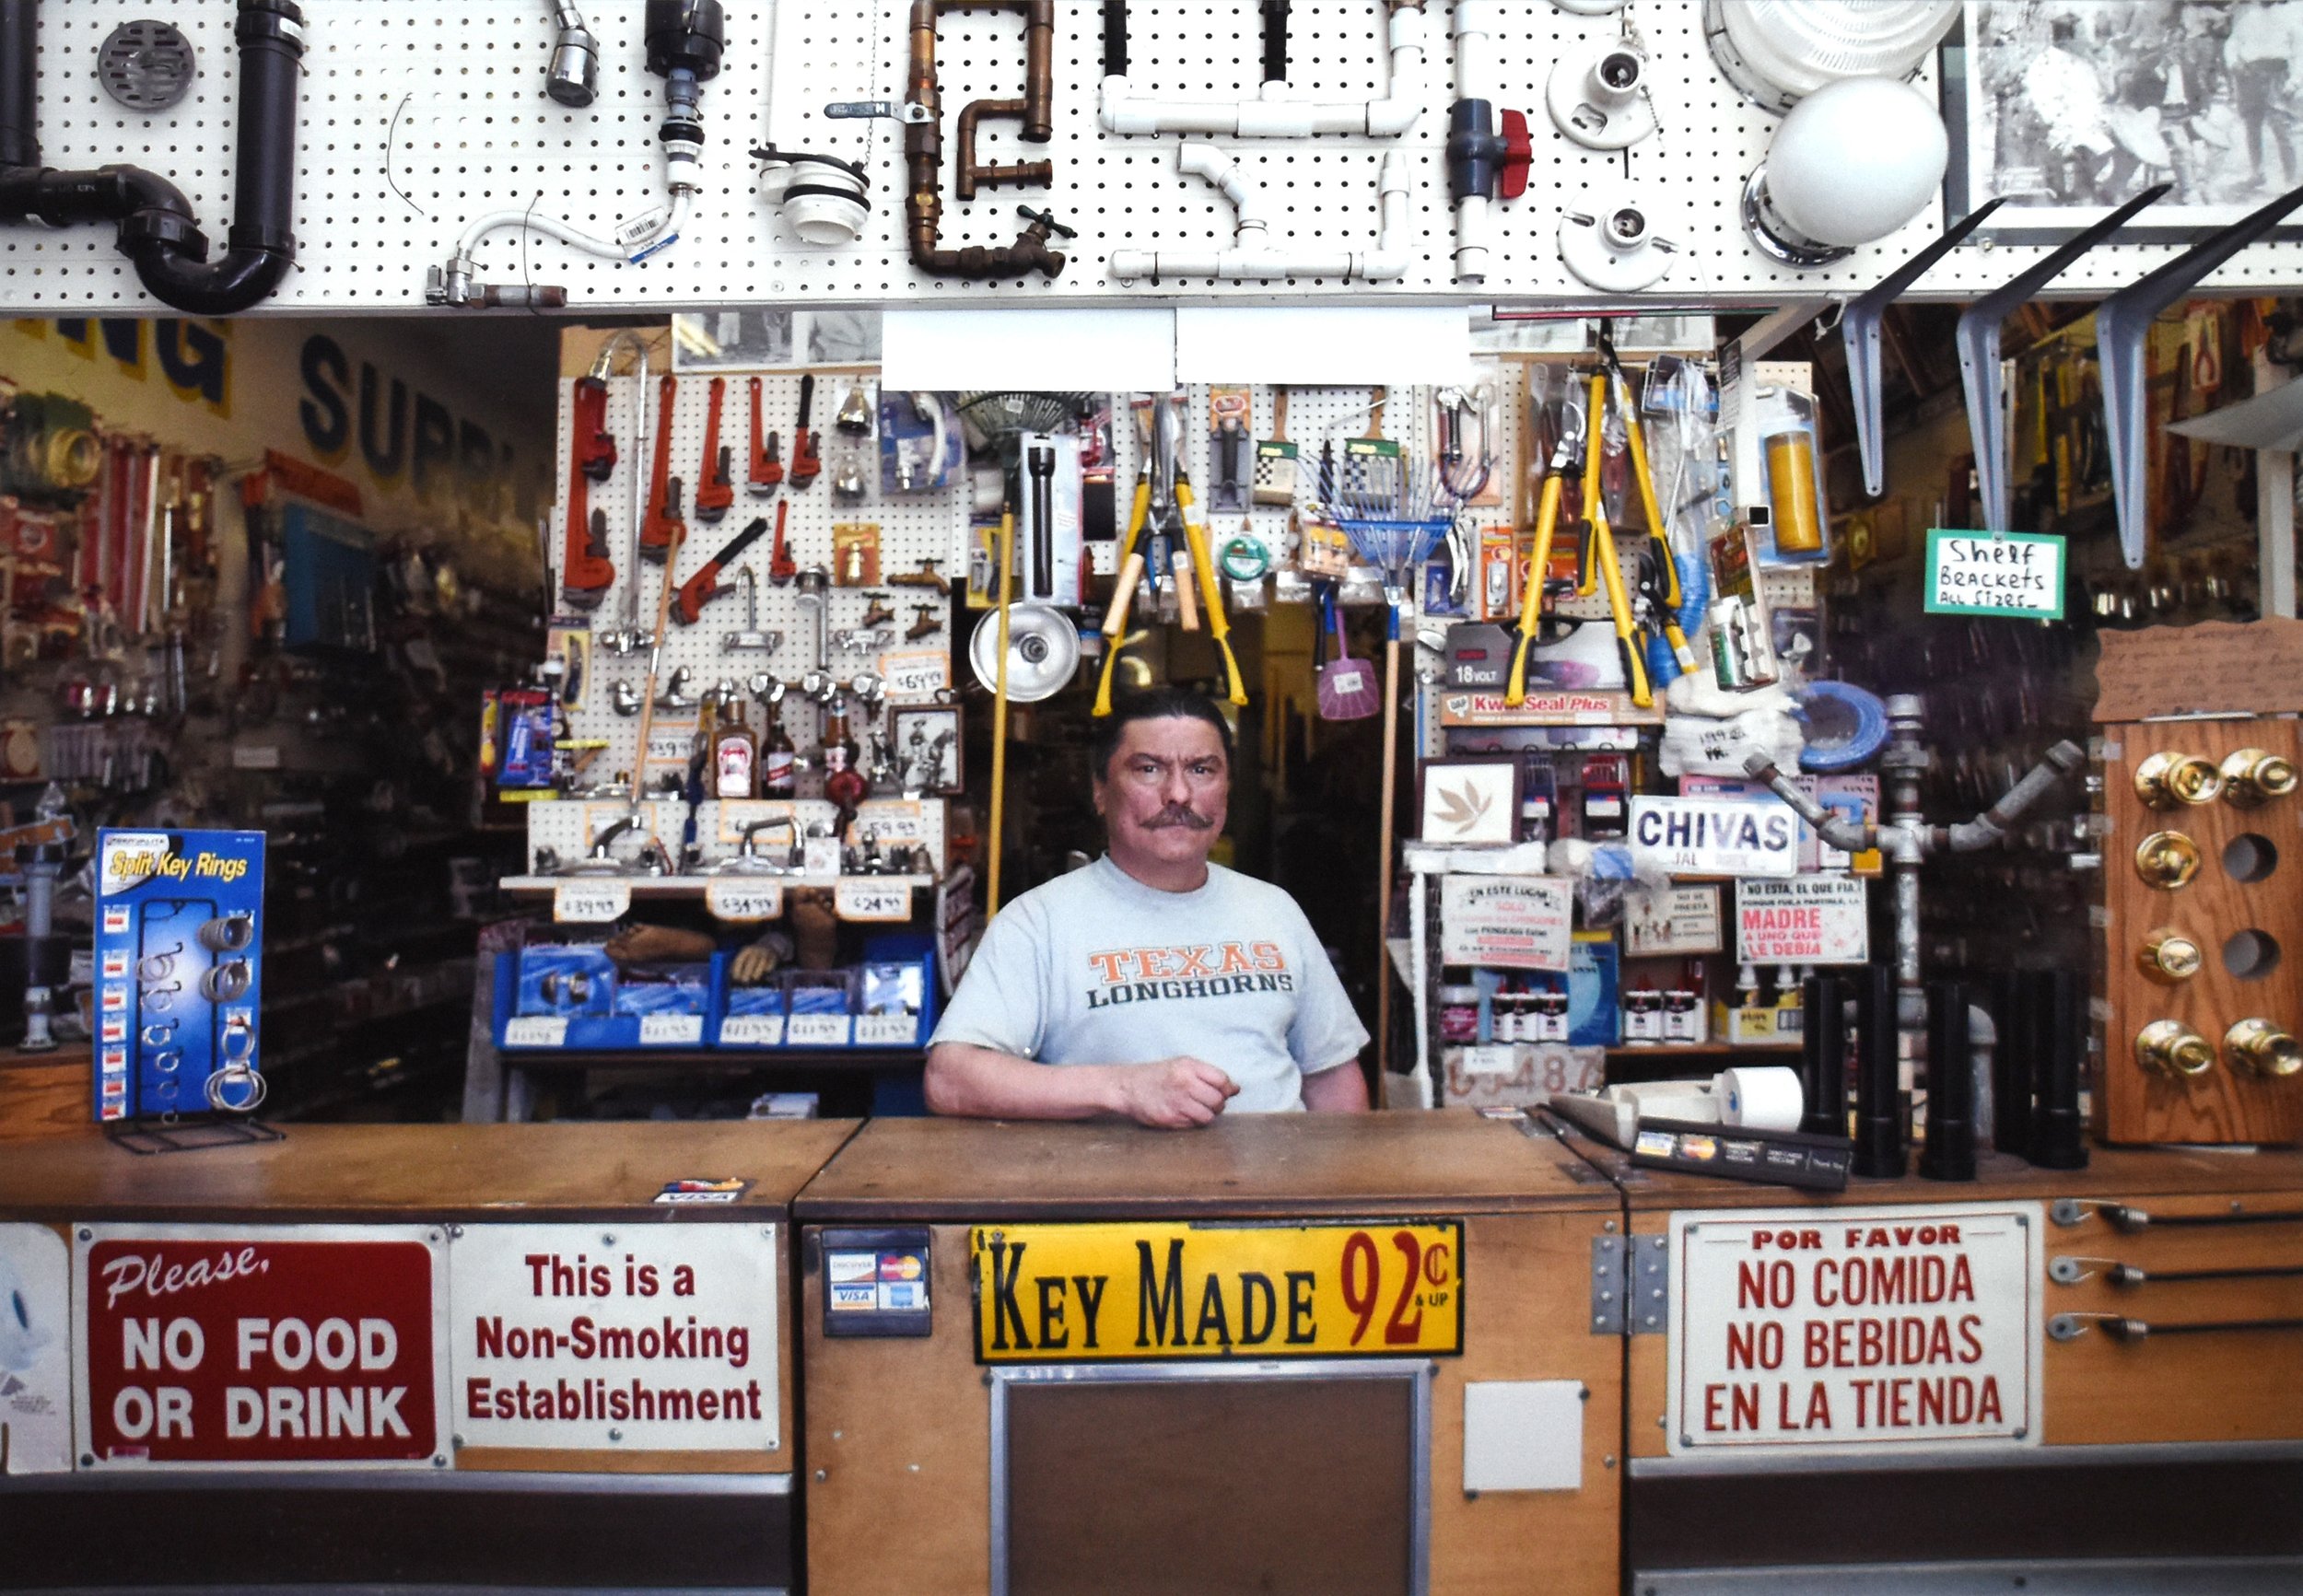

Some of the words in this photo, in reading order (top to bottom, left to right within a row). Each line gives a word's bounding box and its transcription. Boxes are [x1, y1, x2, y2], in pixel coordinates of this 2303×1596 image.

[1949, 540, 2036, 565] Shelf
[1455, 665, 1474, 683] 18
[1474, 671, 1497, 682] VOLT
[1525, 694, 1564, 710] Seal
[1569, 694, 1608, 710] Plus
[1637, 810, 1789, 852] CHIVAS
[111, 850, 155, 881] Split
[156, 851, 193, 882] Key
[195, 852, 249, 882] Rings
[1487, 885, 1511, 895] ESTE
[1514, 886, 1549, 899] LUGAR
[1748, 883, 1761, 895] NO
[1797, 883, 1808, 894] EL
[1812, 882, 1833, 894] QUE
[1742, 906, 1821, 929] MADRE
[1758, 931, 1786, 940] UNO
[1792, 930, 1822, 940] QUE
[1088, 939, 1287, 985] TEXAS
[1086, 973, 1294, 1009] LONGHORNS
[1752, 1229, 1822, 1251] POR
[1845, 1225, 1961, 1249] FAVOR
[102, 1247, 271, 1310] Please,
[525, 1252, 612, 1298] This
[625, 1252, 660, 1298] is
[673, 1264, 696, 1298] a
[989, 1240, 1108, 1350] KEY
[1135, 1238, 1317, 1347] MADE
[1738, 1259, 1794, 1309] NO
[1813, 1253, 1975, 1308] COMIDA
[839, 1291, 870, 1301] VISA
[1428, 1292, 1449, 1308] UP
[123, 1317, 205, 1371] NO
[237, 1317, 398, 1371] FOOD
[475, 1315, 750, 1368] Non-Smoking
[1726, 1321, 1784, 1370] NO
[1804, 1314, 1983, 1369] BEBIDAS
[113, 1385, 193, 1439] OR
[226, 1386, 412, 1439] DRINK
[466, 1377, 762, 1421] Establishment
[1704, 1382, 1759, 1431] EN
[1779, 1380, 1831, 1430] LA
[1849, 1375, 2003, 1429] TIENDA
